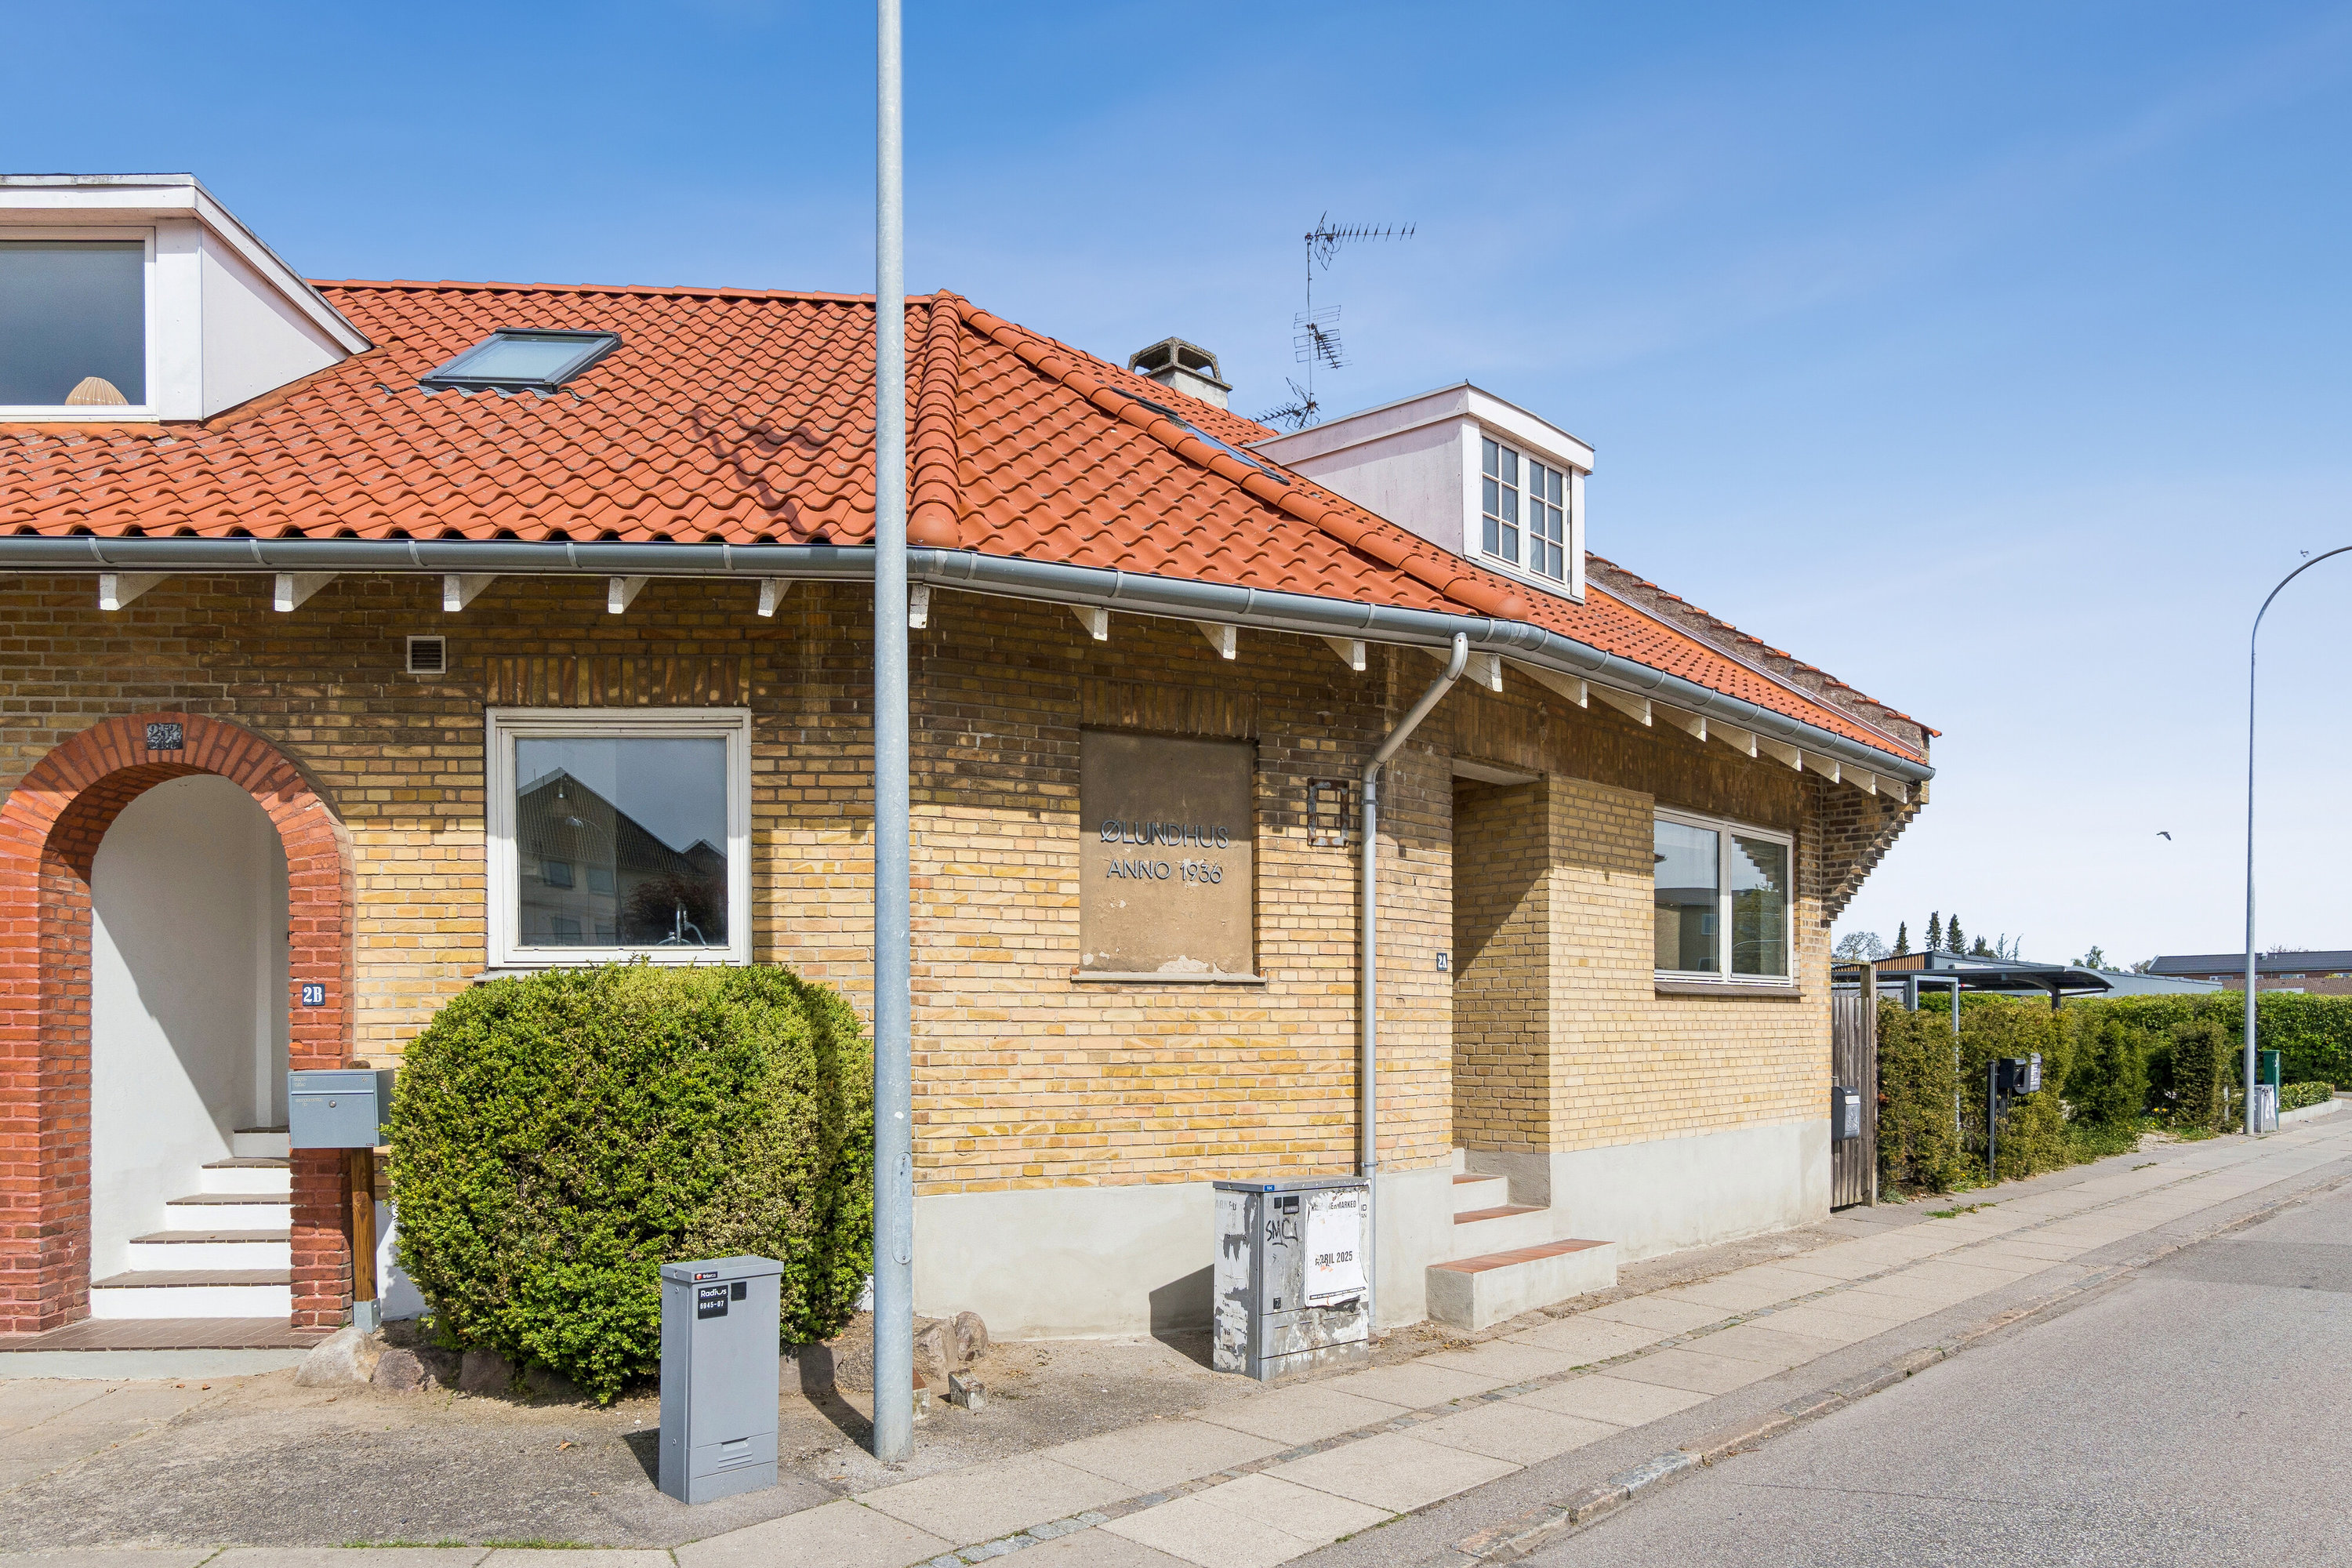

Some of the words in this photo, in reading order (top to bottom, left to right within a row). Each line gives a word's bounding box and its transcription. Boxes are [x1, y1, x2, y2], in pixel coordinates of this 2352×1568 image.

[1101, 819, 1229, 848] ØLUNDHUS
[1106, 859, 1171, 880] ANNO
[1180, 862, 1222, 883] 1936
[1438, 954, 1447, 968] 2A
[303, 986, 322, 1003] 2B
[1336, 1250, 1352, 1263] 2025
[700, 1288, 728, 1298] Radius
